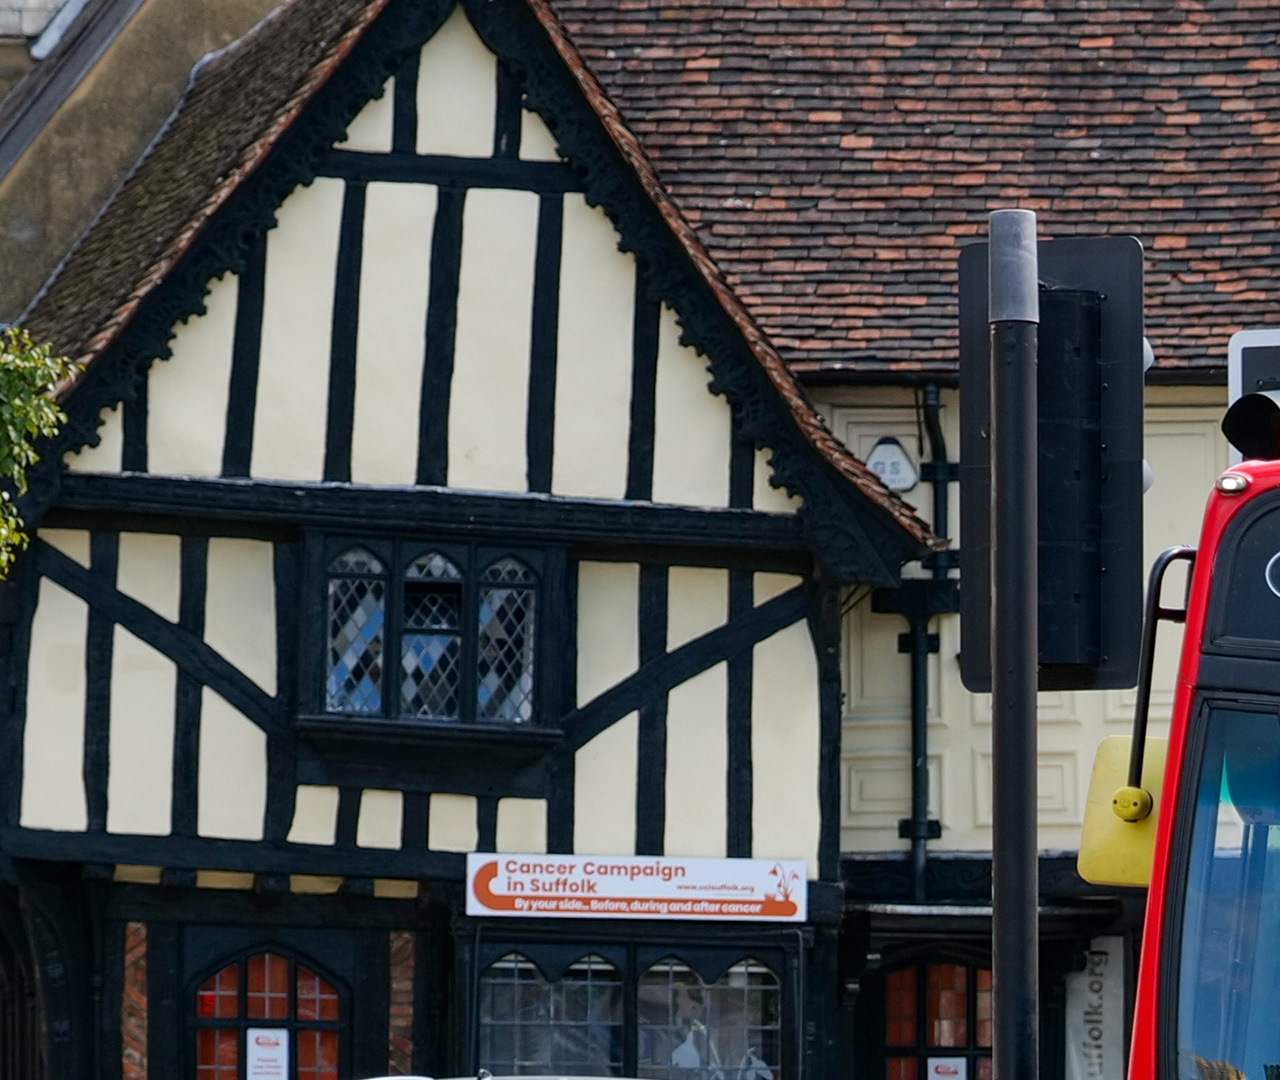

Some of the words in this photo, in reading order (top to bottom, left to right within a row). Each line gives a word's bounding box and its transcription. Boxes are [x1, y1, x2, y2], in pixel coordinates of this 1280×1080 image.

[505, 860, 576, 875] Cancer
[582, 861, 686, 881] Campaign
[507, 877, 525, 892] in
[530, 878, 597, 893] Suffolk
[530, 899, 557, 910] your
[630, 900, 667, 914] during
[669, 901, 691, 912] and
[692, 901, 720, 912] after
[721, 903, 762, 913] cancer
